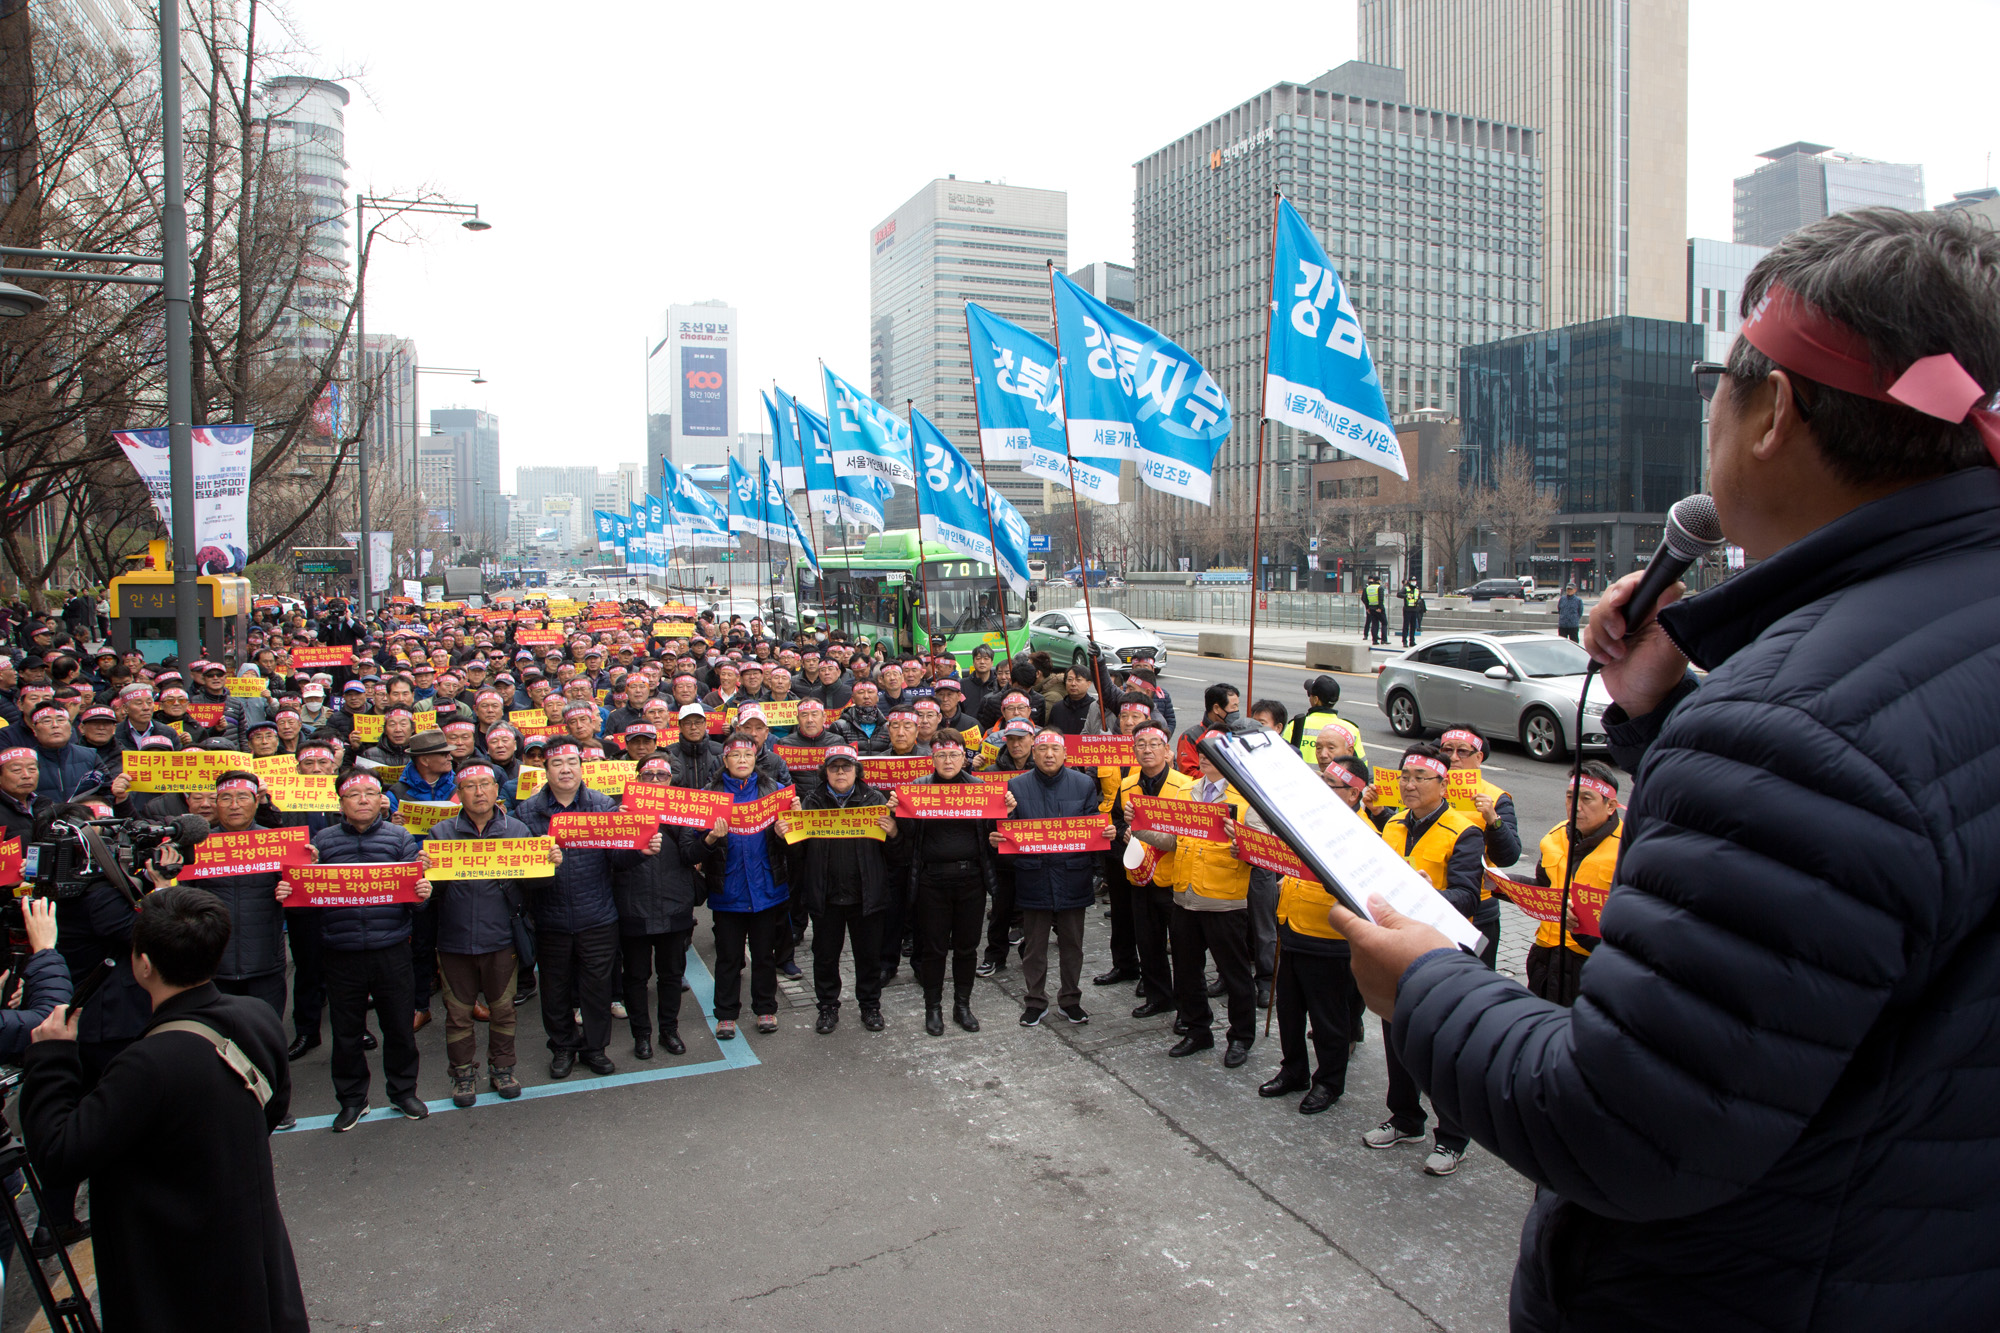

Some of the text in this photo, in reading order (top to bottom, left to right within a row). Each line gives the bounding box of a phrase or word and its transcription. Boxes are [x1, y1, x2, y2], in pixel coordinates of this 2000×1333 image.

[679, 322, 729, 334] 조선일보
[680, 333, 728, 342] chosun.com
[686, 371, 723, 389] 100
[689, 391, 721, 400] 창간 100년
[330, 646, 352, 654] 방조하는
[356, 716, 380, 725] 렌터카
[511, 711, 533, 720] 렌터카
[777, 746, 825, 756] 영리카풀행위
[127, 754, 251, 767] 렌터카 불법 택시영업
[785, 756, 812, 764] 정부는
[1426, 758, 1446, 774] 퇴출
[599, 762, 637, 774] 택시영업
[1331, 764, 1353, 782] 퇴출
[264, 776, 328, 788] 렌터카 불법
[863, 771, 890, 780] 정부는
[627, 784, 730, 806] 영리카풀행위 방조하는
[900, 784, 1004, 796] 영리카풀행위 방조하는
[761, 790, 794, 809] 방조하는
[911, 796, 988, 806] 정부는 각성하라!
[402, 804, 460, 816] 렌터카 불법
[634, 798, 713, 816] 정부는 각성하라!
[915, 809, 983, 817] 서울개인택시운송사업조합
[1132, 796, 1227, 817] 영리카풀행위 방조하는
[552, 814, 656, 827] 영리카풀행위 방조하는
[744, 804, 780, 824] 각성하라!
[1144, 809, 1214, 827] 정부는 각성하라!
[1002, 818, 1106, 831] 영리카풀행위 방조하는
[1150, 822, 1209, 838] 서울개인택시운송사업조합
[254, 830, 306, 846] 방조하는
[558, 826, 640, 839] 정부는 각성하라!
[1013, 830, 1092, 842] 정부는 각성하라!
[1234, 824, 1277, 848] 영리카풀행위
[428, 839, 552, 854] 렌터카 불법 택시영업
[564, 840, 635, 848] 서울개인택시운송사업조합
[1018, 842, 1086, 852] 서울개인택시운송사업조합
[231, 846, 287, 860] 각성하라!
[1242, 840, 1268, 856] 정부는
[1268, 844, 1302, 868] 각성하라!
[194, 861, 280, 876] 서울개인택시운송사업조합
[1249, 854, 1300, 878] 서울개인택시운송사업조합
[288, 866, 418, 880] 영리카풀행위 방조하는
[454, 869, 525, 878] 서울개인택시운송사업조합
[304, 880, 400, 894] 정부는 각성하라!
[310, 894, 394, 906] 서울개인택시운송사업조합
[1577, 888, 1608, 906] 영리
